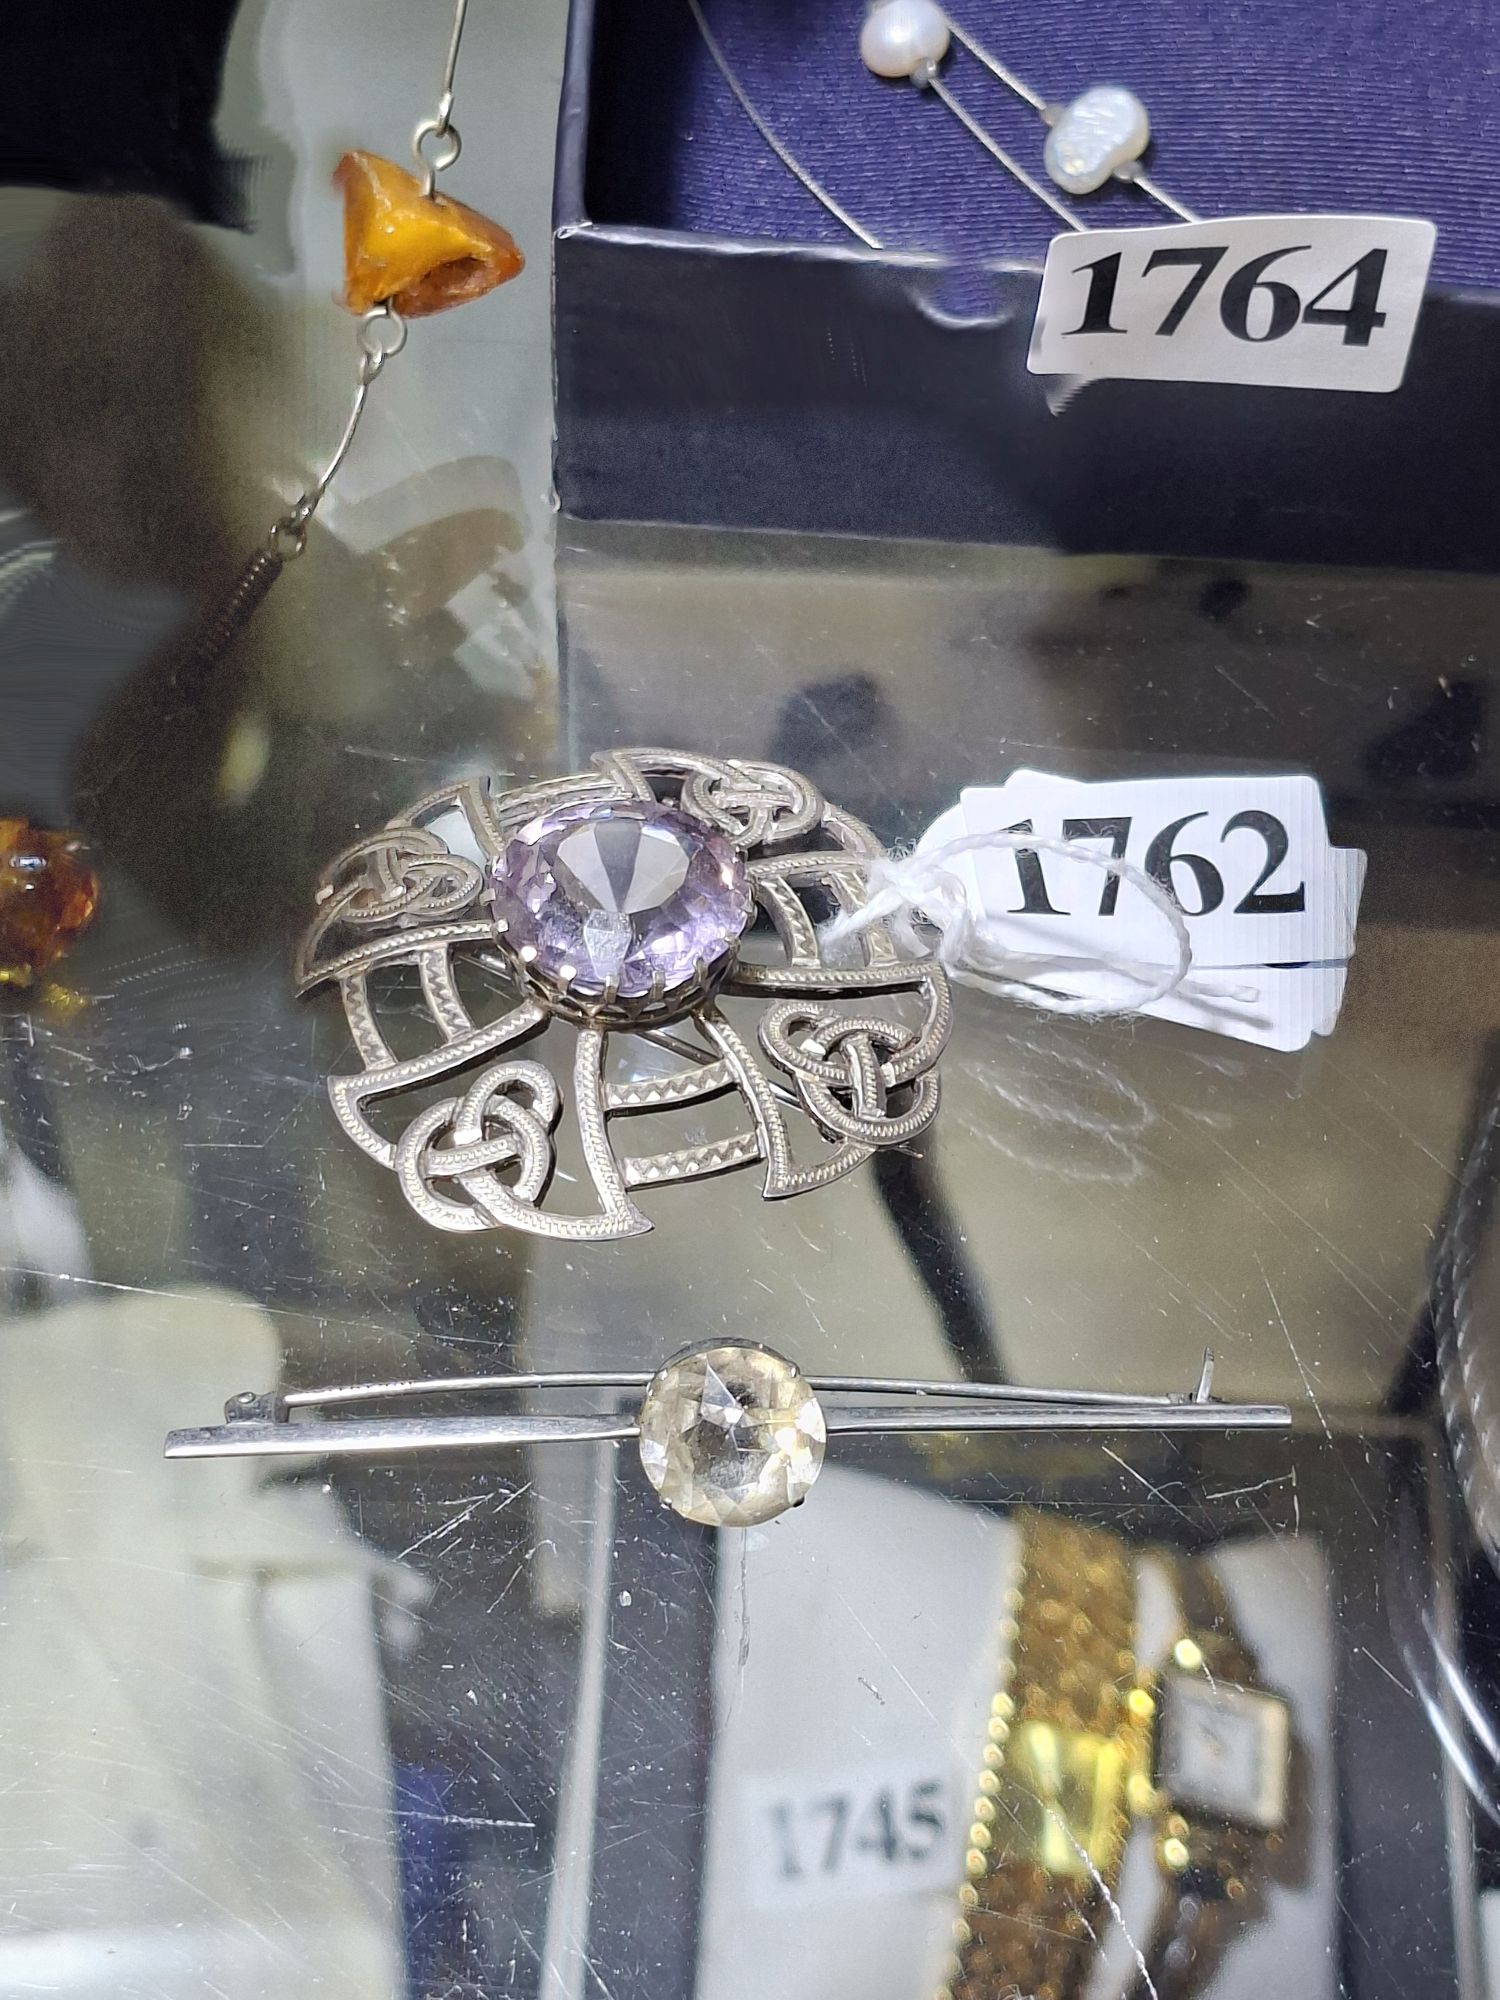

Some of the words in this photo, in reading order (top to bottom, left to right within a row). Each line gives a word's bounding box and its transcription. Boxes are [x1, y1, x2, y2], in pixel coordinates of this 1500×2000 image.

[1061, 245, 1388, 347] 1764
[1000, 809, 1306, 917] 1762
[766, 1780, 944, 1877] 1745
